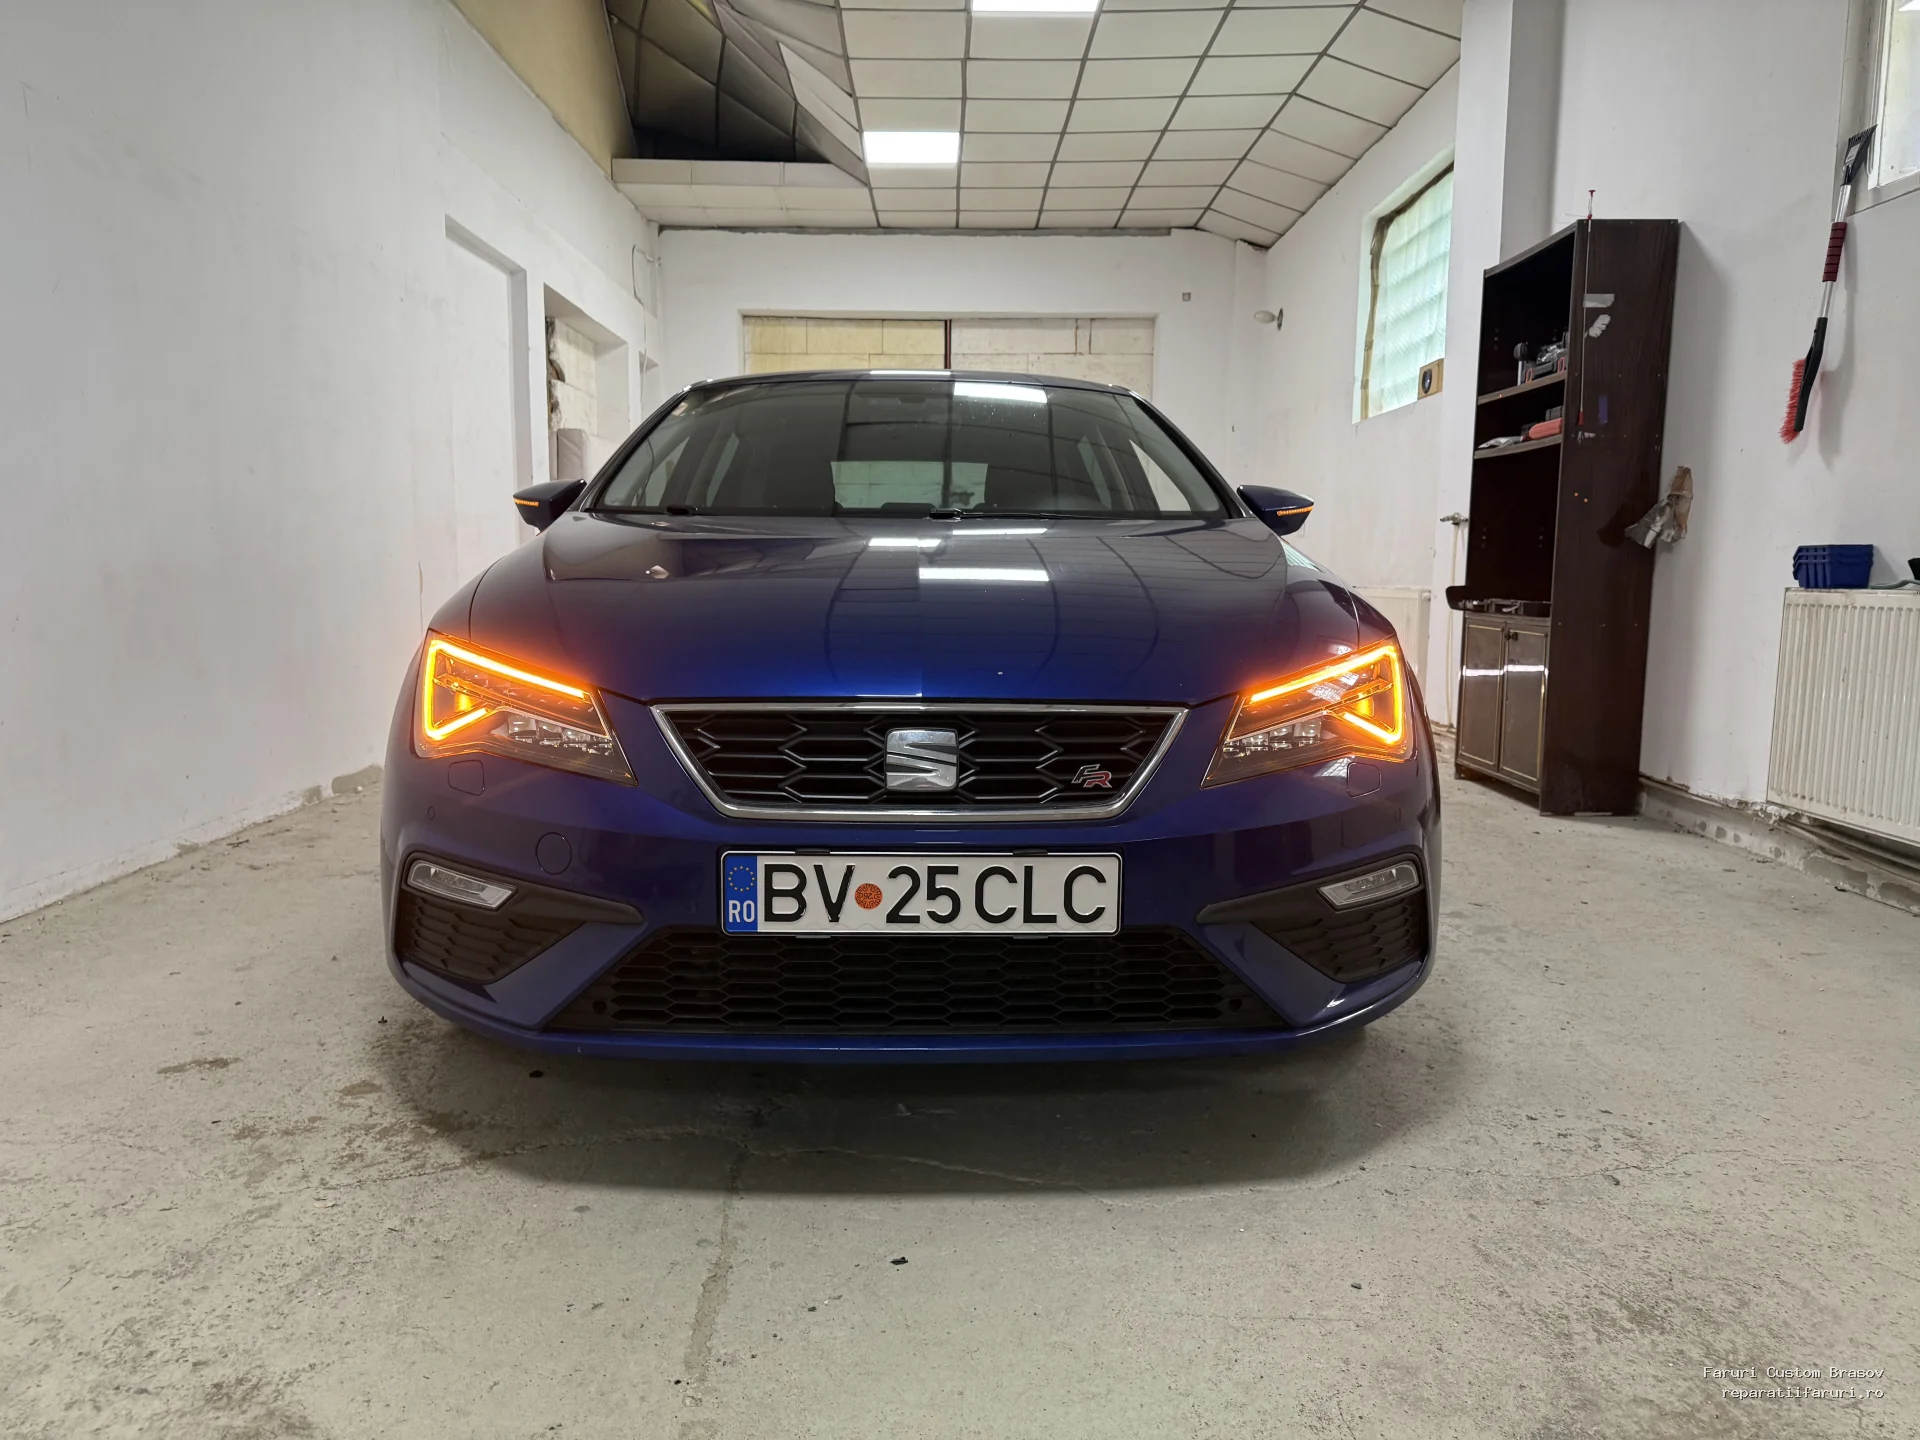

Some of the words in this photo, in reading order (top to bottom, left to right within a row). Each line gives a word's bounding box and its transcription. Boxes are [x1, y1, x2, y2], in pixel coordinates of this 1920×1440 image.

[1071, 764, 1112, 788] FR
[764, 863, 855, 923] BV
[886, 865, 960, 924] 25
[974, 865, 1107, 924] CLC
[728, 900, 755, 923] RO
